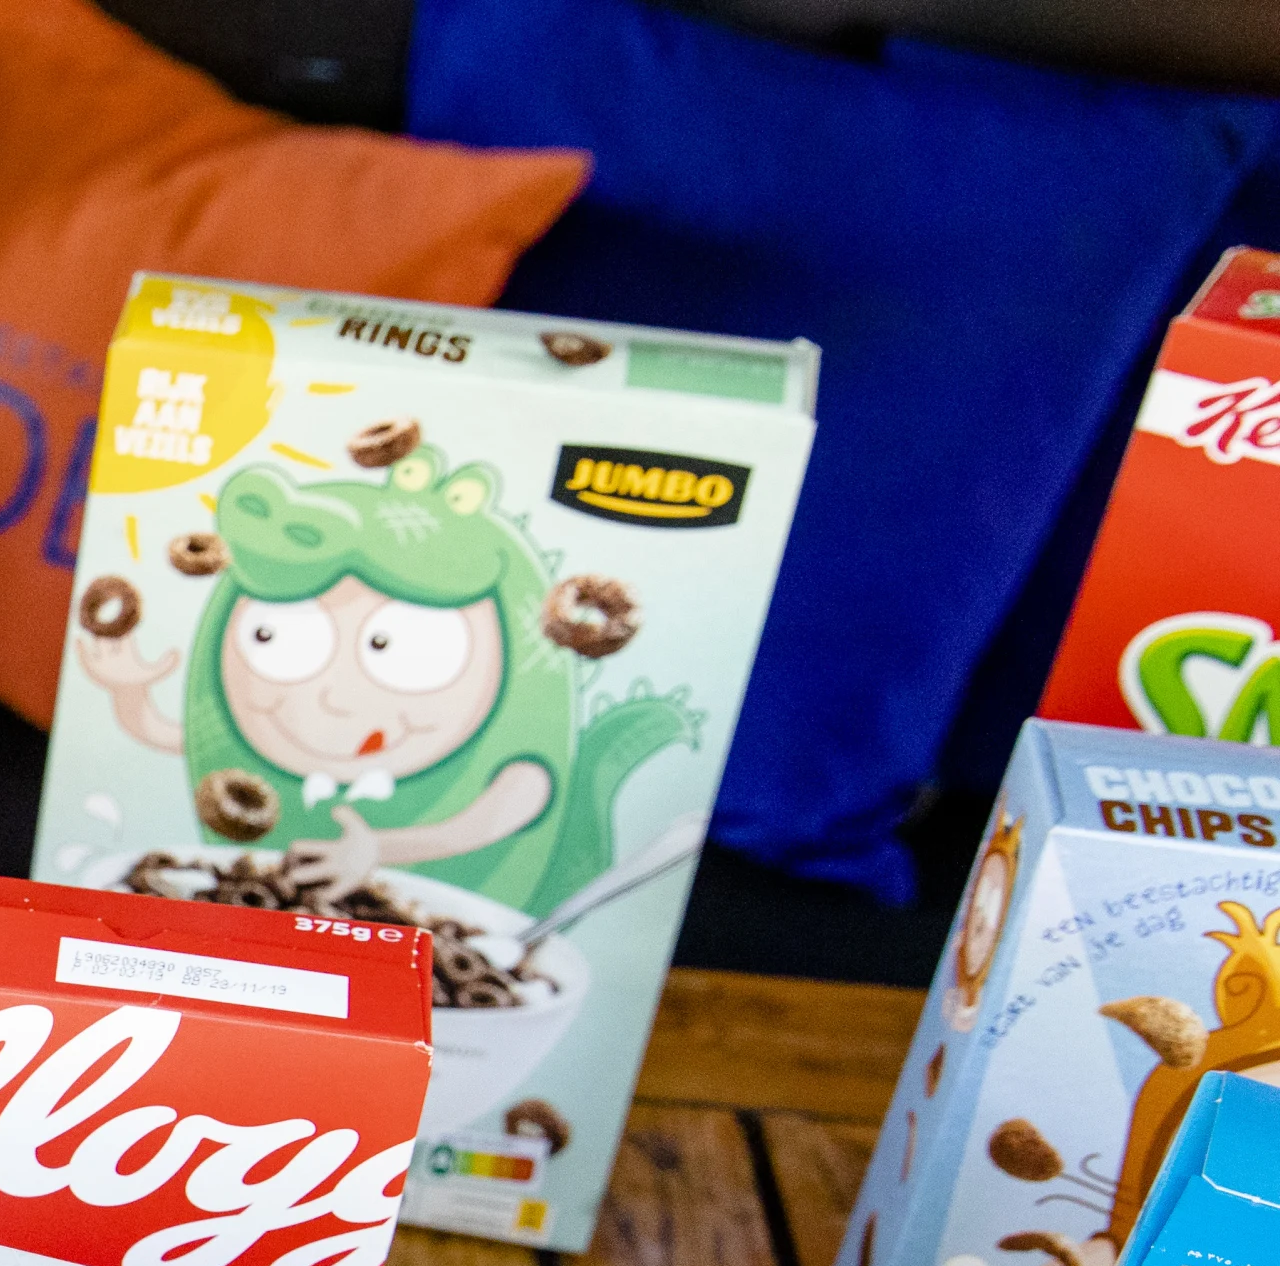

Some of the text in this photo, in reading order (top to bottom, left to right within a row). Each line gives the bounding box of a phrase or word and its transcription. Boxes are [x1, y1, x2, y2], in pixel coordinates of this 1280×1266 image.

[338, 315, 474, 367] RINGS
[564, 455, 735, 512] JUMBO
[1099, 799, 1277, 848] CHIPS
[294, 916, 372, 942] 375g
